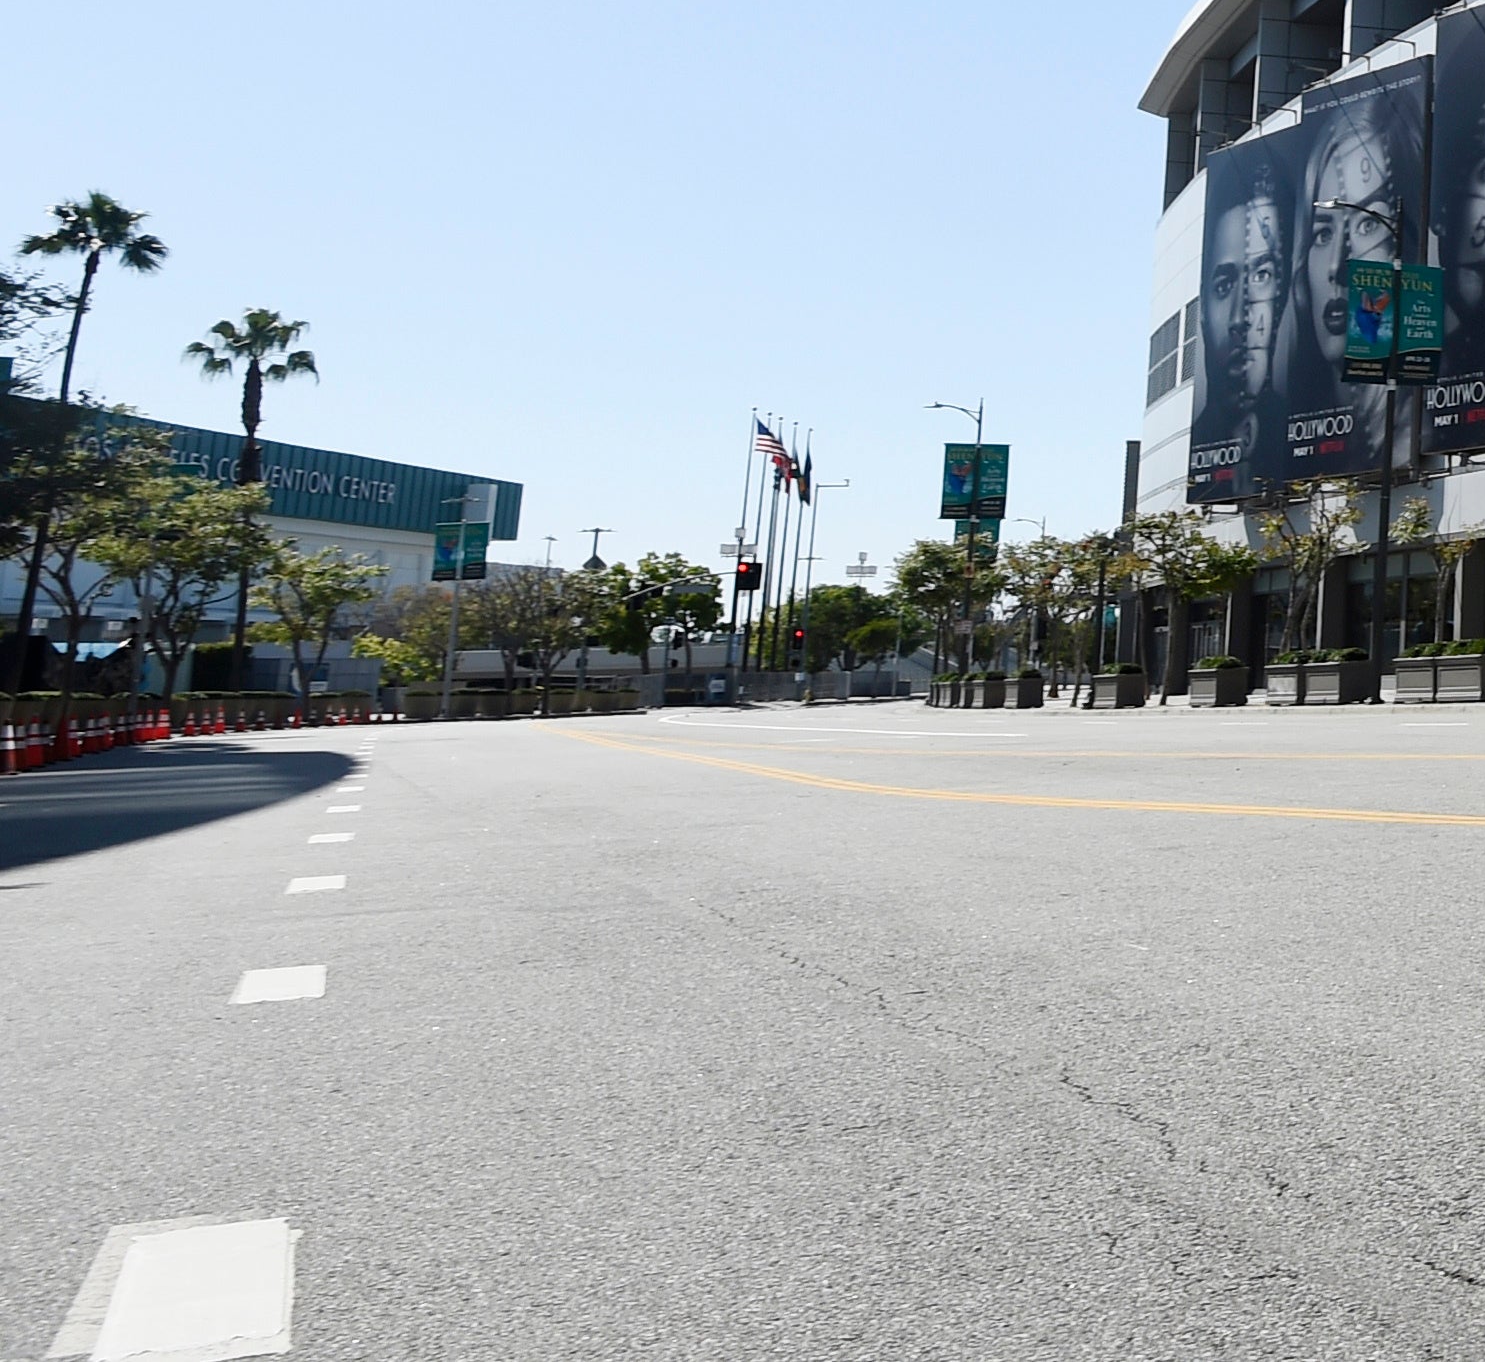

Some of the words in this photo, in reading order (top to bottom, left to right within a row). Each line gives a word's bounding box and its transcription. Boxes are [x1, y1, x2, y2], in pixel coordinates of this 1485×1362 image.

[1361, 158, 1371, 183] 9
[1352, 273, 1392, 288] SHEN
[1401, 278, 1433, 292] YUN
[1412, 304, 1431, 313] Arts
[1256, 313, 1266, 336] 4
[1403, 316, 1437, 327] Heaven
[1406, 328, 1434, 339] Earth
[1288, 414, 1354, 442] HOLLYWOOD
[1434, 415, 1453, 427] MAY
[1454, 414, 1459, 424] 1
[1190, 445, 1242, 470] HOLLYWOOD
[1293, 446, 1308, 457] MAY
[217, 456, 332, 494] COVENTION
[339, 475, 396, 504] CENTER
